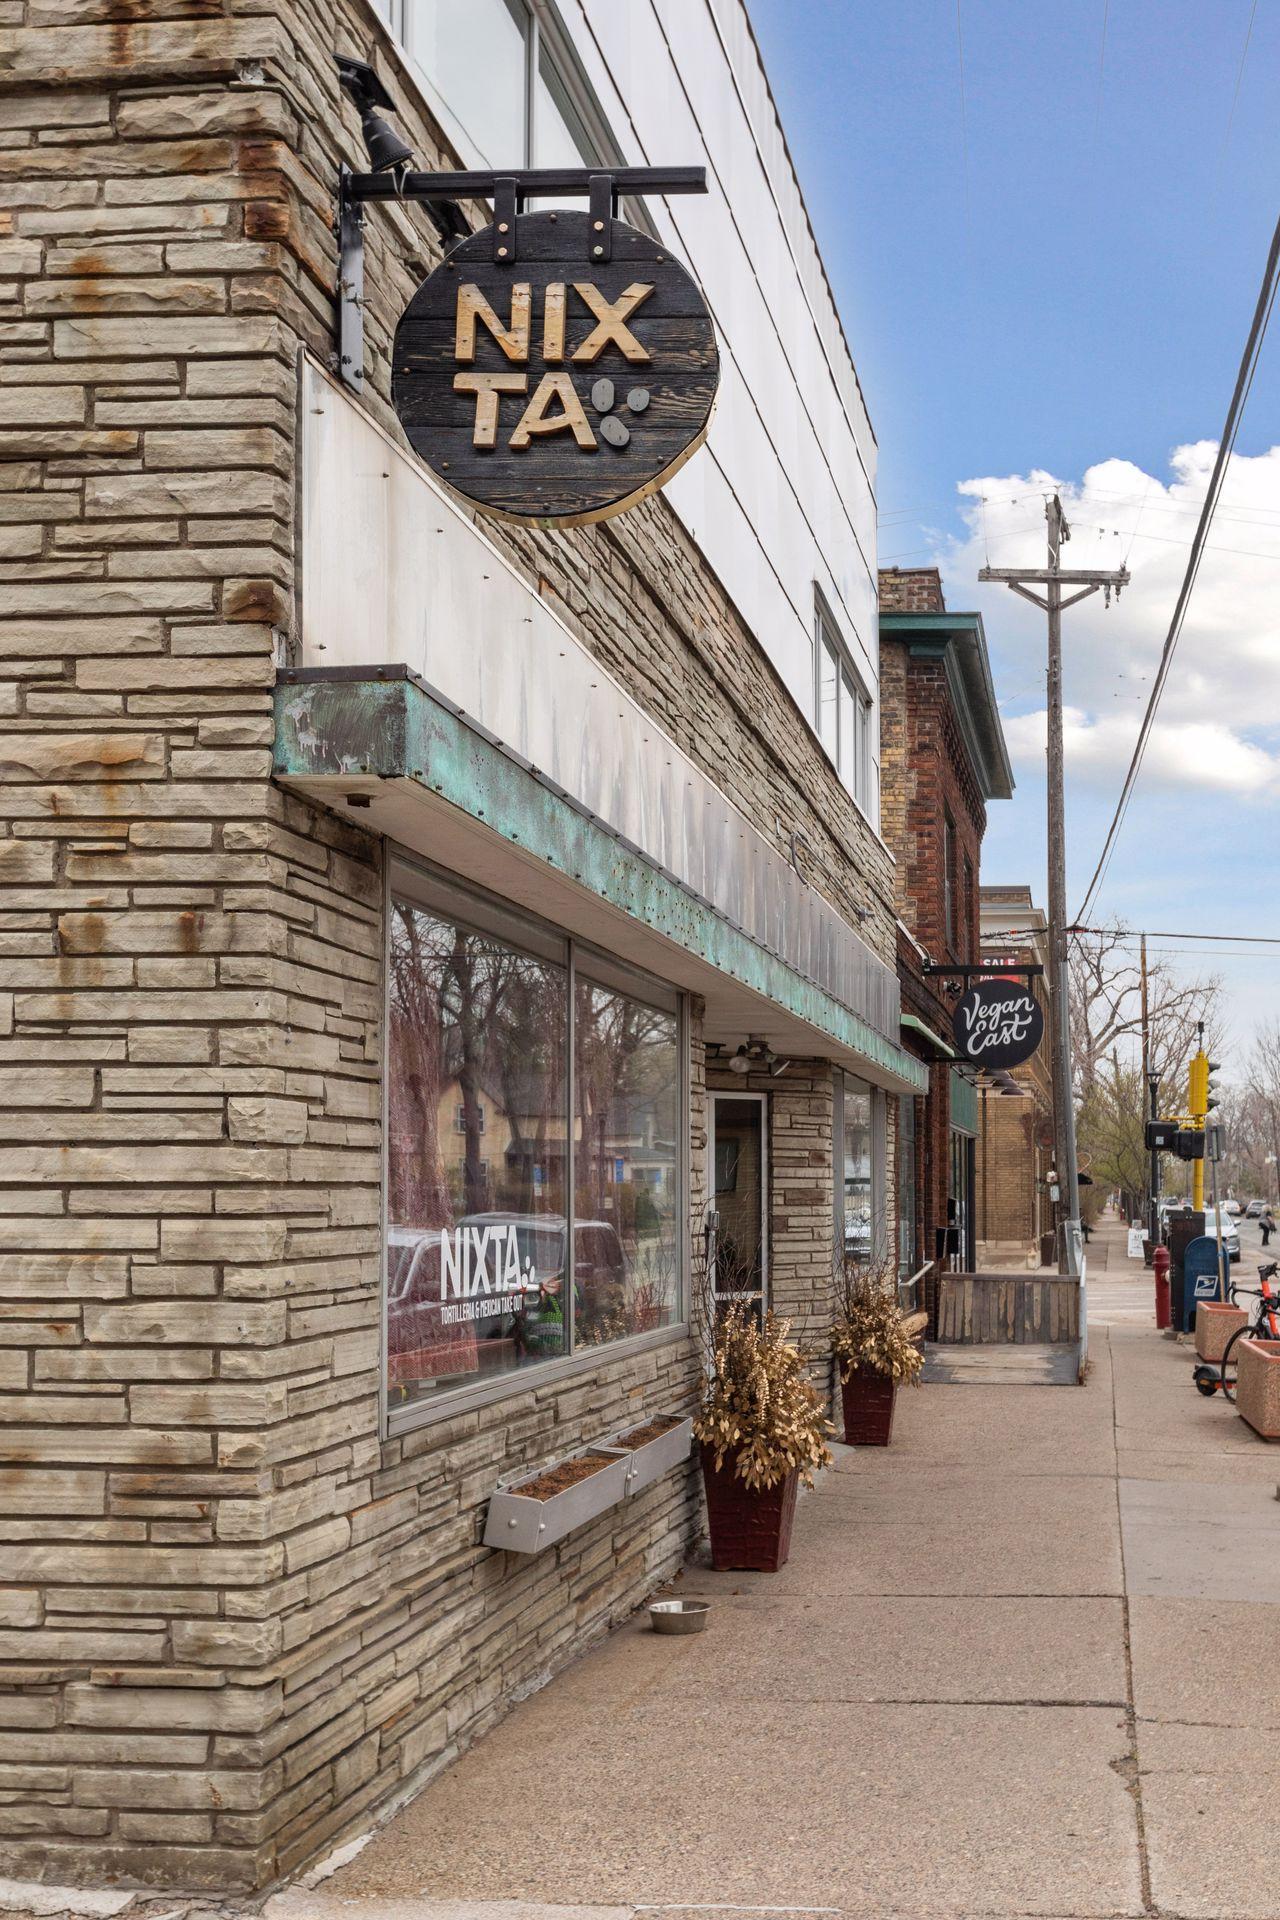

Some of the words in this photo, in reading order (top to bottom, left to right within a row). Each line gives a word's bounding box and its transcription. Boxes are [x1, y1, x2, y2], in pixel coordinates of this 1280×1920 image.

[454, 282, 655, 363] NIX
[453, 372, 597, 449] TA
[963, 993, 1034, 1031] Vegan
[967, 1014, 1032, 1055] East
[440, 1225, 522, 1300] NIXTA
[441, 1302, 475, 1325] TORTILLERIA
[480, 1298, 500, 1318] MEXICAN
[501, 1296, 513, 1314] TAKE
[513, 1294, 523, 1311] OUT
